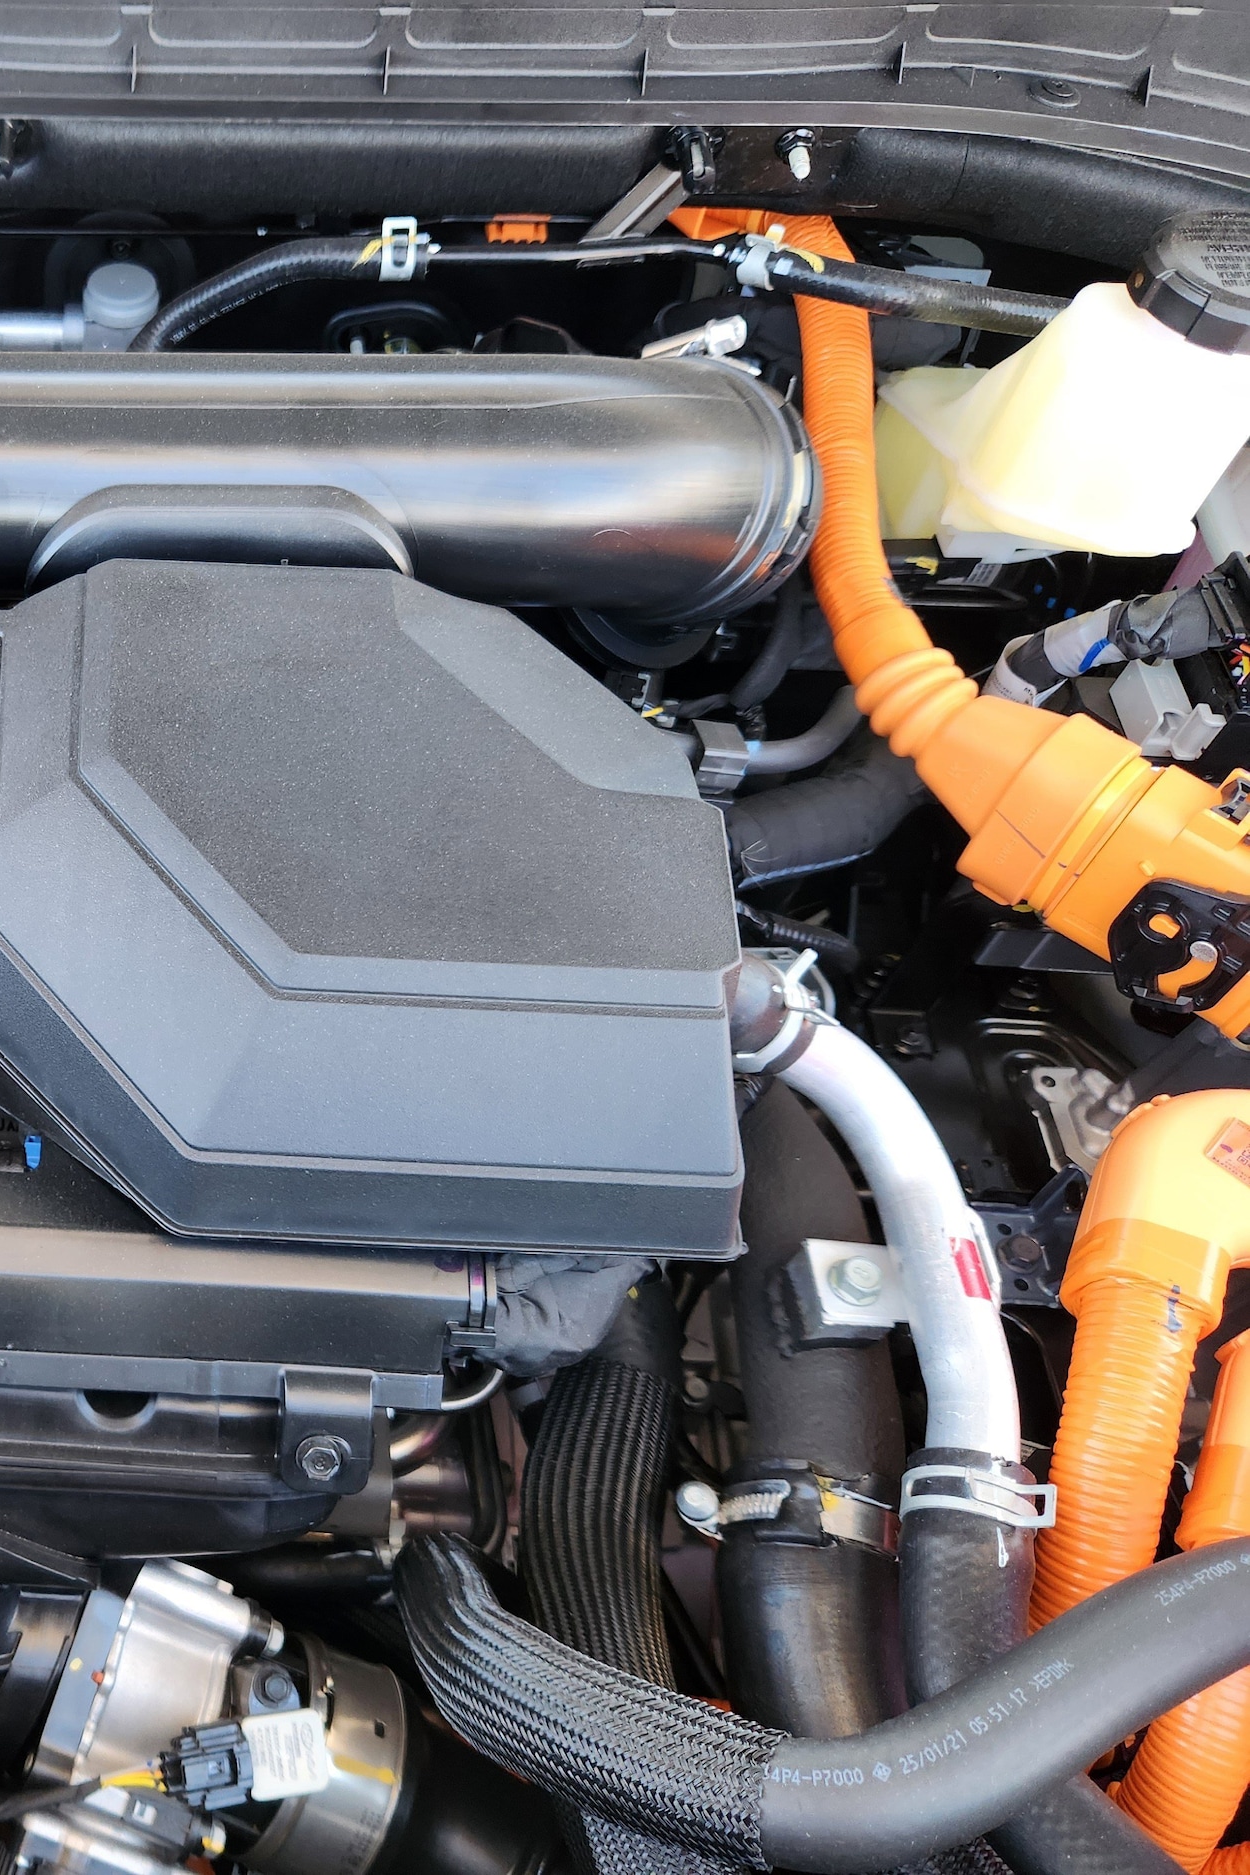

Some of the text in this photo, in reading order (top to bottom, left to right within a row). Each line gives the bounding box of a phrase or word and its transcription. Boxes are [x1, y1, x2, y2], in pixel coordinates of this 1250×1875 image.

[1154, 1559, 1237, 1606] 254P4-P7000
[898, 1729, 968, 1775] 25/01/21
[969, 1687, 1028, 1736] 05:51:17
